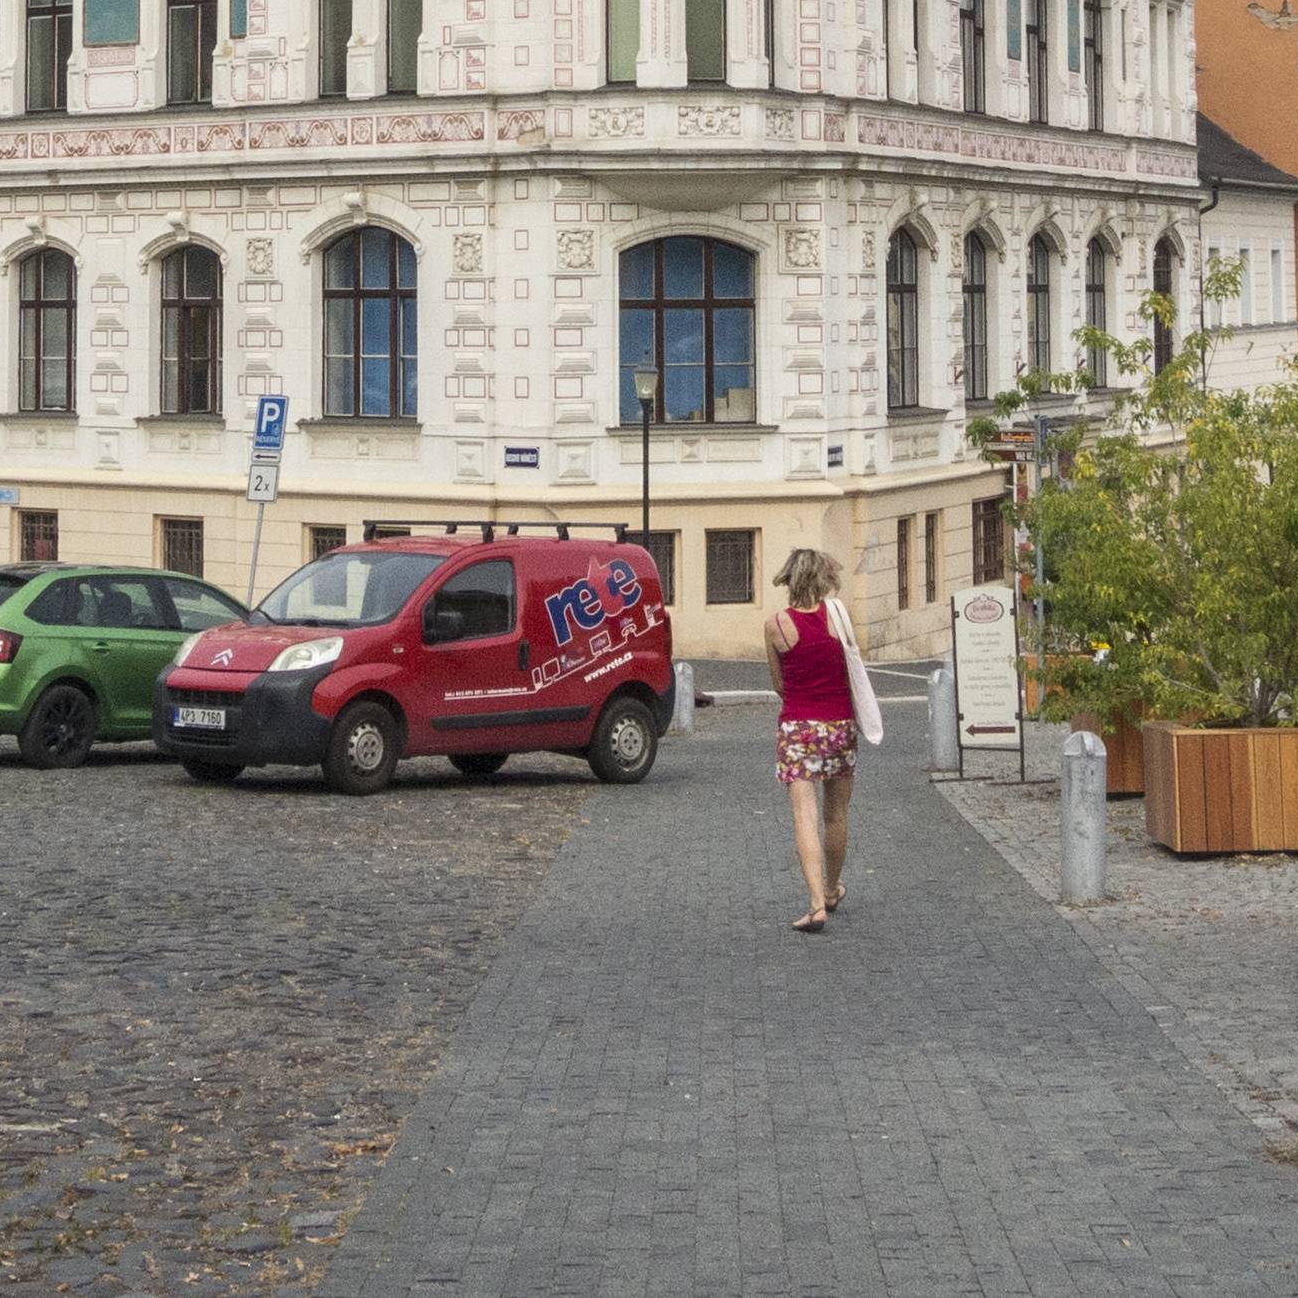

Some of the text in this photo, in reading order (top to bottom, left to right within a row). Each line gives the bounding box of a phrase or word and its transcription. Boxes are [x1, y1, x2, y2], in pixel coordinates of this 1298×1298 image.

[260, 402, 280, 433] P
[545, 556, 642, 647] rete
[583, 651, 634, 683] www.rete.cz
[201, 711, 222, 724] 7160
